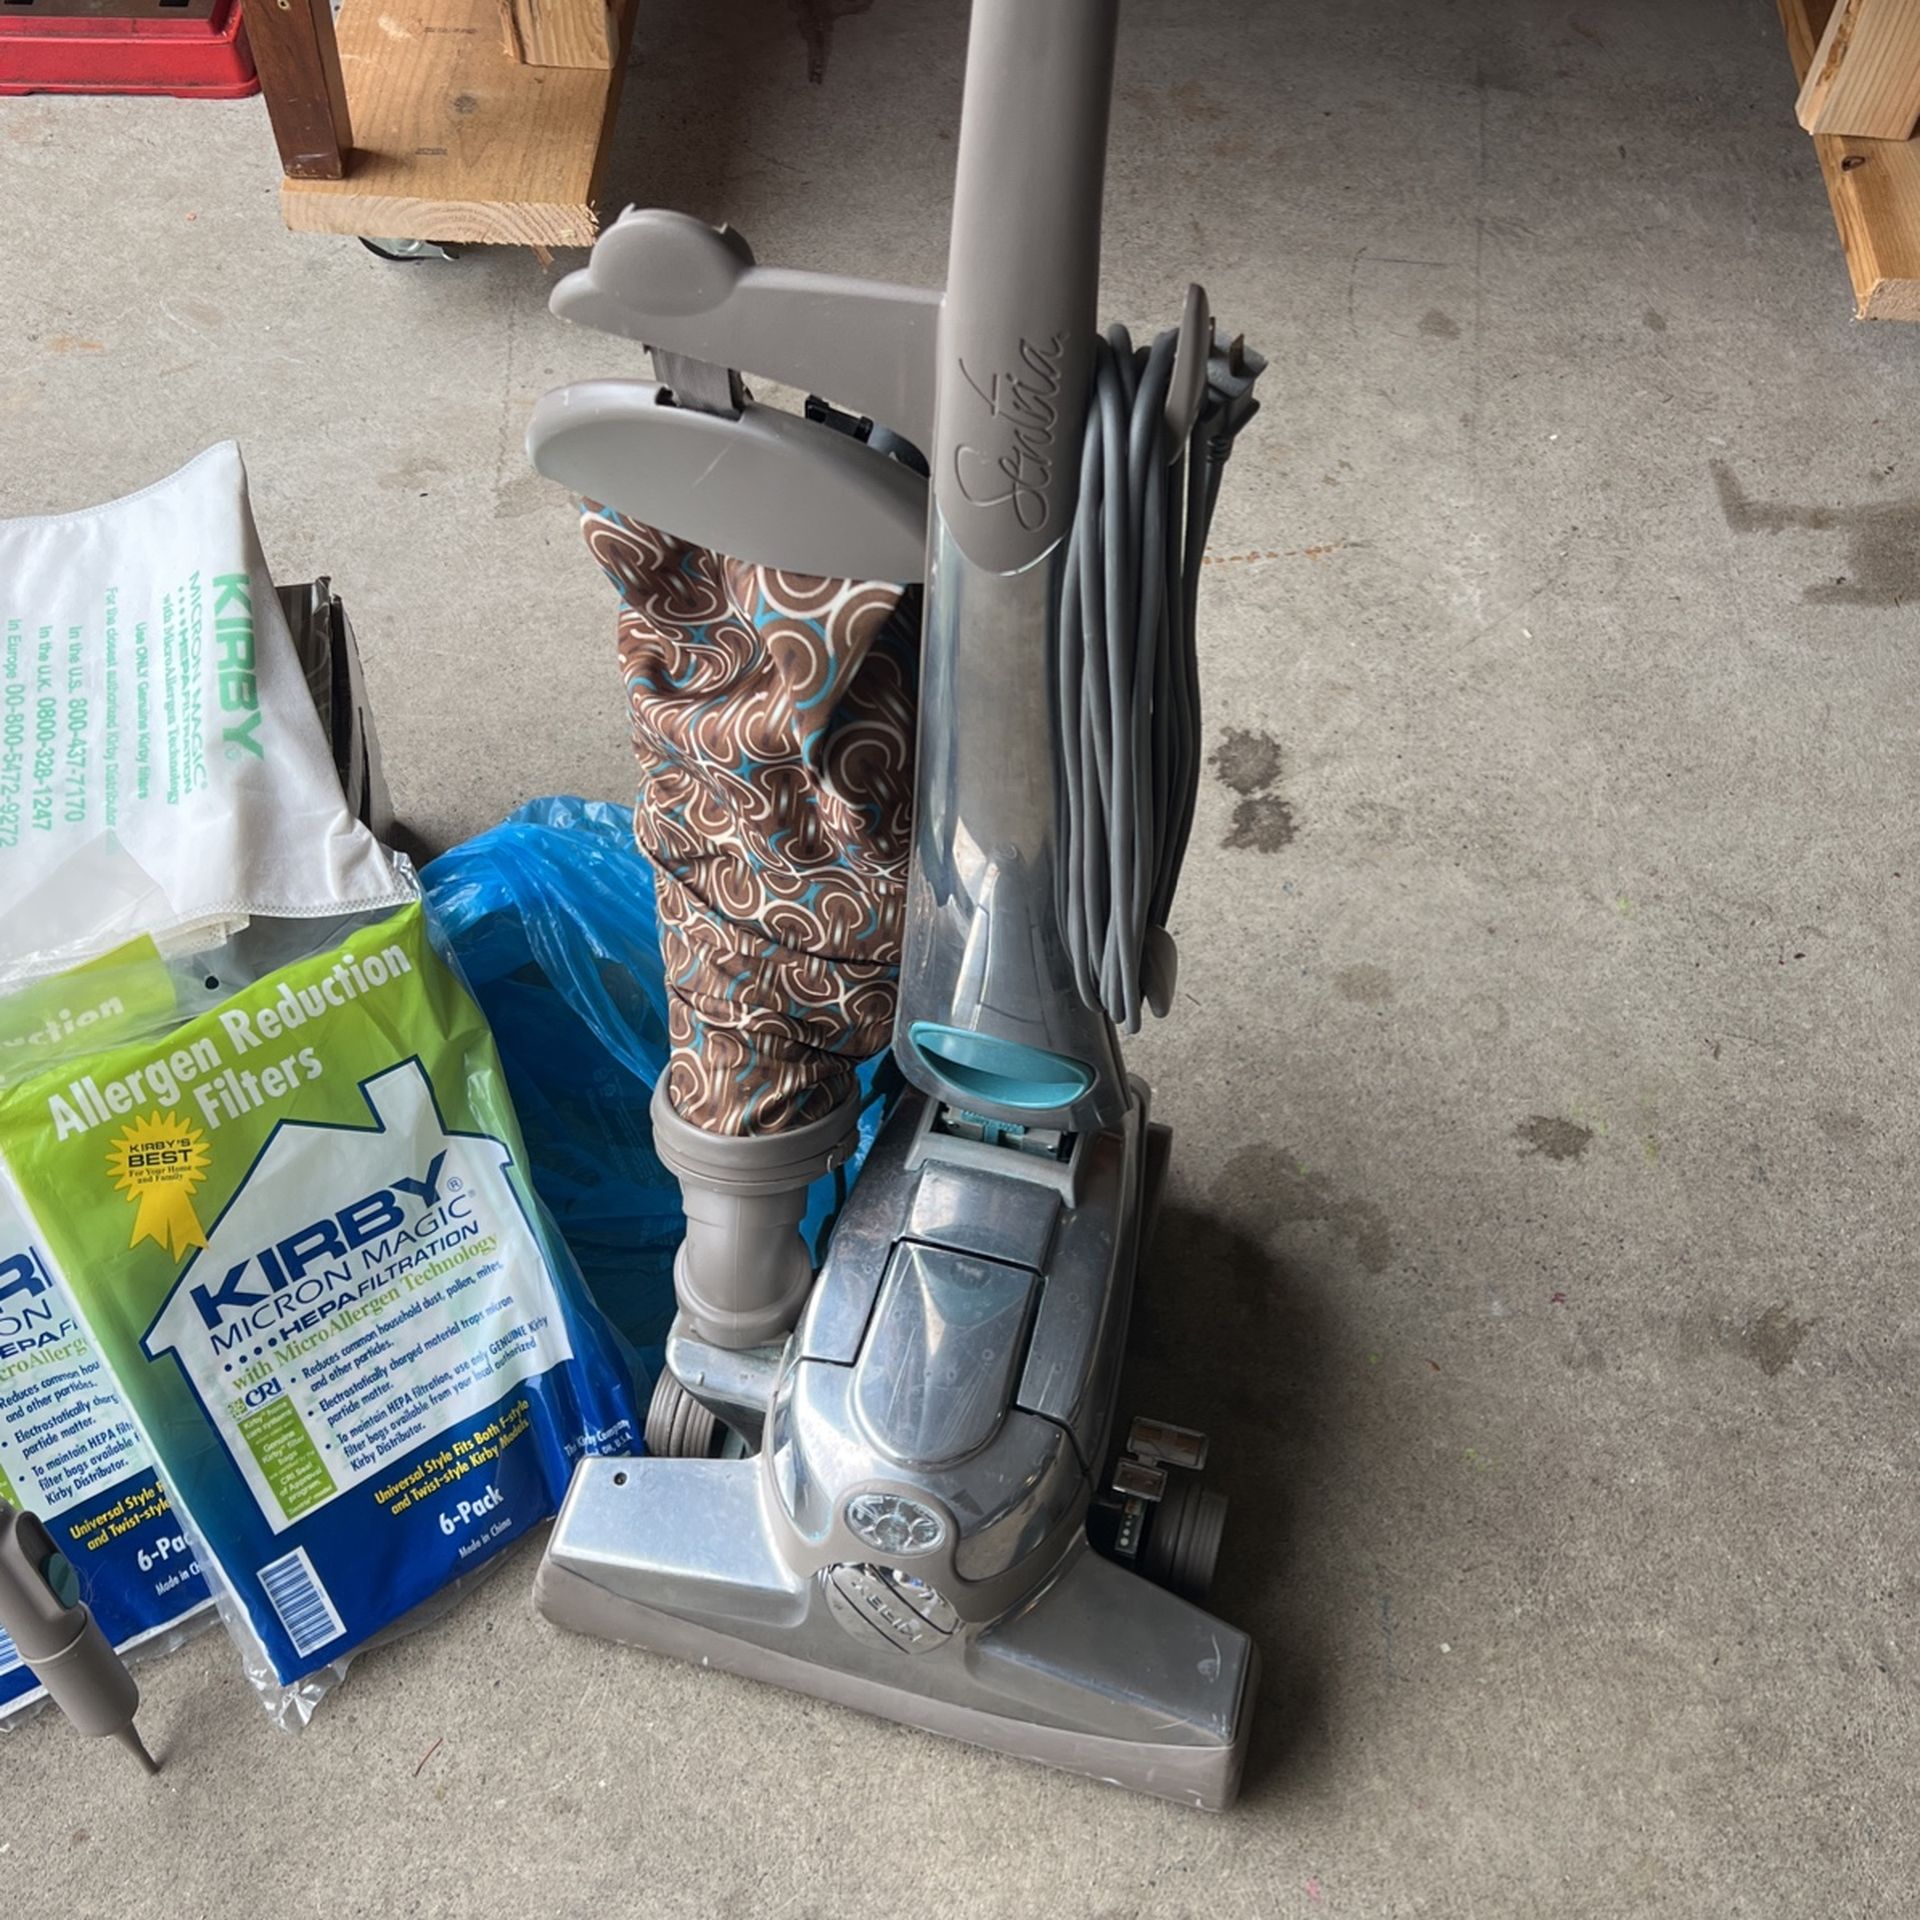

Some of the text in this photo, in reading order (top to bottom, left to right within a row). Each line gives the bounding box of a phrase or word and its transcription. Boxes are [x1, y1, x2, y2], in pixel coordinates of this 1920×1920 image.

[954, 333, 1064, 533] Sentria
[105, 587, 118, 605] For
[105, 607, 117, 625] the
[105, 627, 117, 667] closest
[212, 573, 264, 761] KIRBY
[162, 593, 179, 804] with MicroAllergen Technology
[188, 571, 206, 783] MICRON MAGIC
[0, 619, 24, 847] In Europe 00-800-5472-9272
[32, 625, 56, 830] In the U.K. 0800-328-1247
[64, 626, 87, 822] In the U.S. 800-437-7170
[135, 622, 150, 799] Use ONLY Genuine Kirby filters
[103, 731, 118, 760] Kirby
[104, 763, 118, 826] Distributor
[47, 944, 411, 1141] Allergen Reduction
[193, 1046, 322, 1128] Filters
[129, 1138, 190, 1153] KIRBY'S
[129, 1149, 192, 1168] BEST
[191, 1151, 447, 1328] KIRBY
[210, 1194, 471, 1355] MICRON MAGIC
[279, 1220, 478, 1340] HEPAFILTRATION
[232, 1235, 496, 1390] with MicroAllergen Technology
[301, 1352, 340, 1378] Reduces
[340, 1330, 378, 1356] common
[375, 1301, 422, 1334] household
[421, 1291, 445, 1309] dust,
[445, 1275, 476, 1298] pollen,
[40, 1369, 80, 1389] common
[244, 1376, 282, 1407] CRI
[309, 1339, 394, 1392] and other particles.
[318, 1365, 388, 1411] Electrostatically
[388, 1343, 423, 1370] charged
[423, 1321, 460, 1349] material
[336, 1432, 348, 1444] To
[348, 1409, 388, 1437] maintain
[386, 1392, 412, 1414] HEPA
[410, 1371, 453, 1398] filtration,
[453, 1360, 470, 1374] use
[488, 1325, 526, 1354] GENUINE
[5, 1404, 25, 1423] and
[25, 1394, 52, 1413] other
[13, 1400, 91, 1443] Electrostatically
[326, 1381, 393, 1428] particle matter.
[343, 1439, 366, 1457] filter
[365, 1426, 389, 1444] bags
[389, 1401, 429, 1429] available
[428, 1388, 451, 1405] from
[451, 1376, 471, 1394] your
[493, 1337, 536, 1369] authorized
[21, 1416, 96, 1459] particle matter.
[30, 1465, 44, 1477] To
[45, 1444, 87, 1470] maintain
[86, 1428, 116, 1448] HEPA
[38, 1472, 63, 1490] filter
[62, 1460, 88, 1478] bags
[89, 1437, 133, 1465] available
[349, 1422, 426, 1471] Kirby Distributor.
[373, 1399, 529, 1503] Universal Style Fits Both F-style
[44, 1485, 73, 1505] Kirby
[72, 1458, 128, 1489] Distributor.
[390, 1419, 529, 1514] and Twist-style Kirby Models
[69, 1503, 124, 1538] Universal
[124, 1487, 155, 1509] Style
[438, 1484, 503, 1534] 6-Pack
[86, 1530, 109, 1550] and
[457, 1517, 512, 1558] Made in China
[155, 1576, 179, 1595] Made
[179, 1569, 189, 1580] in
